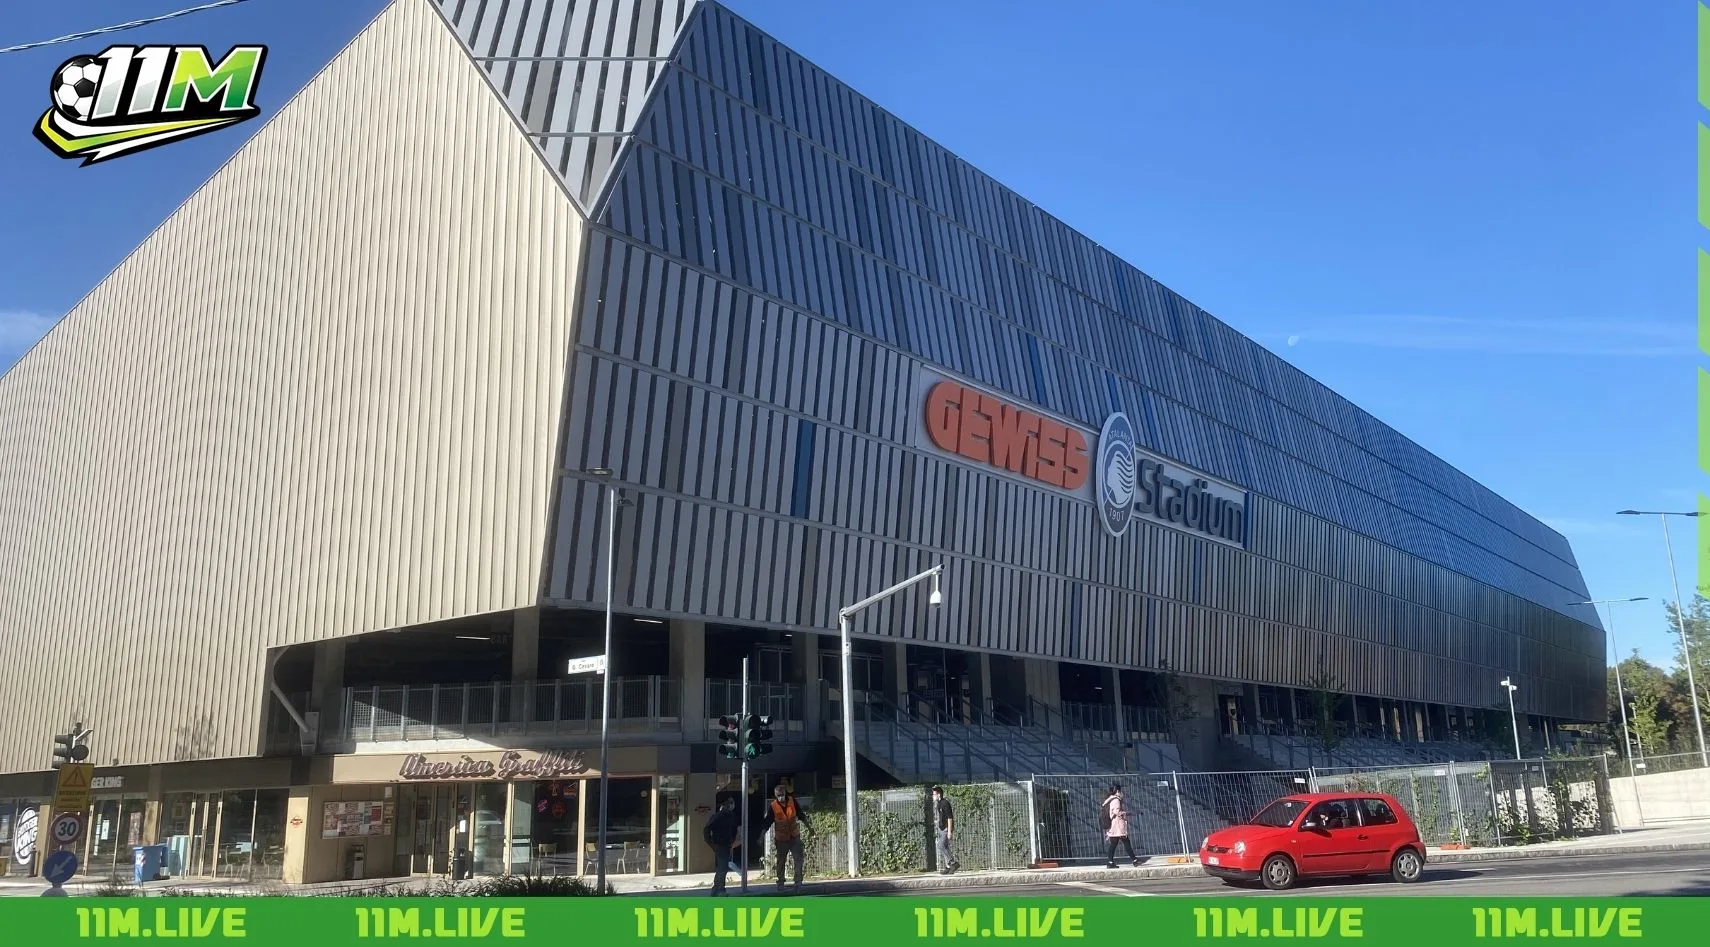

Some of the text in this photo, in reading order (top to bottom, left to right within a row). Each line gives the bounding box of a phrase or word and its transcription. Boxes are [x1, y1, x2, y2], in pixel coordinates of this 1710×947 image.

[1135, 458, 1245, 544] Stadium
[1109, 507, 1124, 522] 1907
[58, 821, 77, 837] 30
